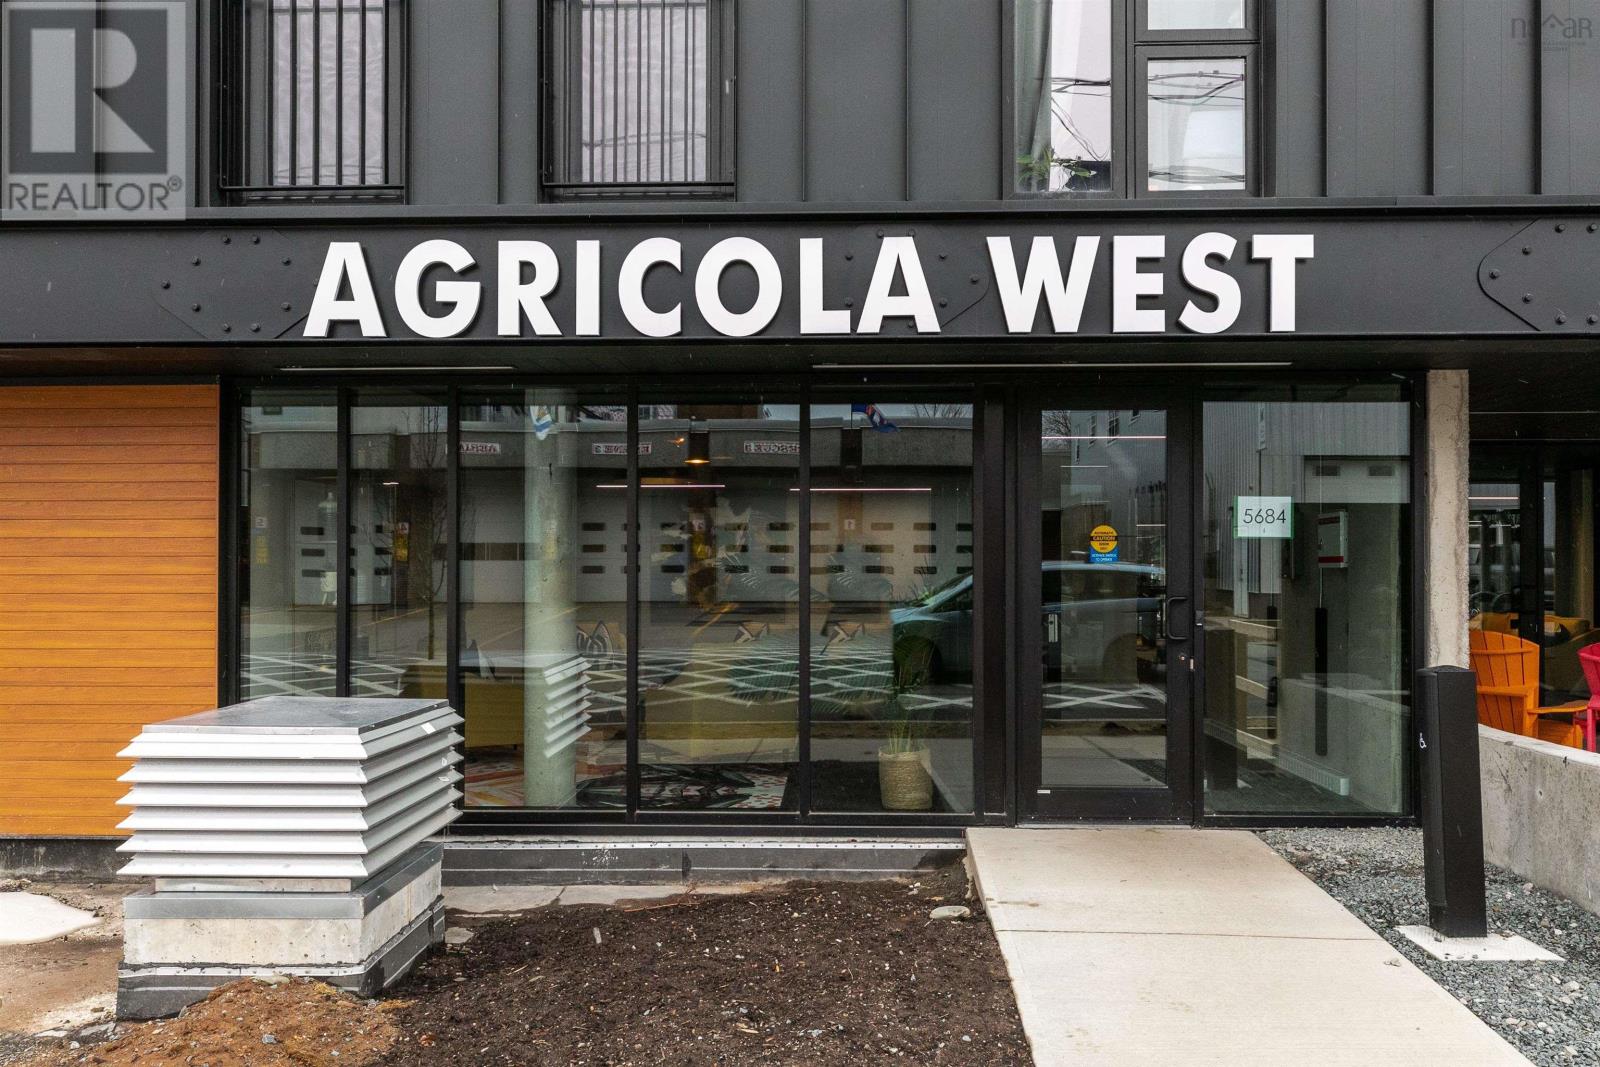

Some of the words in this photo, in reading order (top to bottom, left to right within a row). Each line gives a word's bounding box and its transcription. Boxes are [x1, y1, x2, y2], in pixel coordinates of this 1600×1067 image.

[302, 236, 942, 338] AGRICOLA
[986, 232, 1315, 334] WEST
[1243, 508, 1287, 525] 5684
